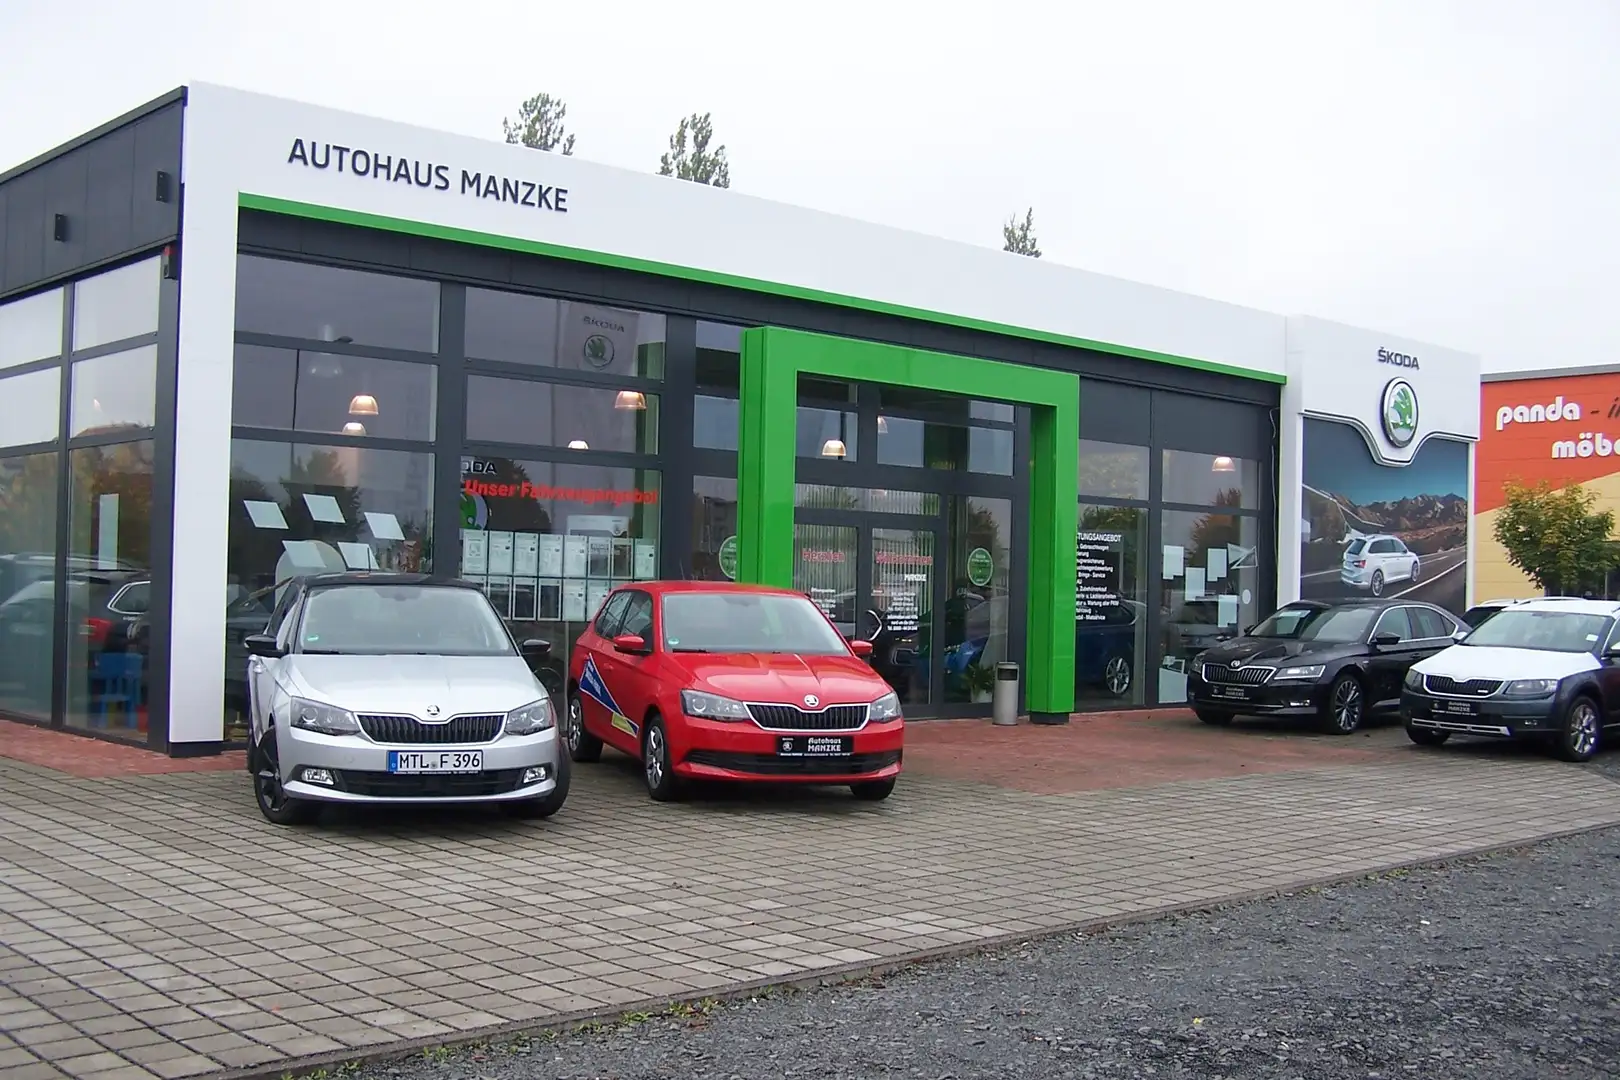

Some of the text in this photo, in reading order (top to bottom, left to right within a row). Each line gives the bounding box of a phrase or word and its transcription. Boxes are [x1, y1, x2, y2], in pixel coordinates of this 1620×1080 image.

[288, 138, 568, 212] AUTOHAUS MANZKE
[1378, 346, 1420, 370] ŠKODA
[1496, 396, 1581, 431] panda
[464, 479, 515, 498] Unser
[1077, 532, 1121, 542] TUNGSANGEBOT
[807, 744, 841, 752] MANZKE
[808, 737, 841, 745] Autohaus
[400, 753, 480, 768] MTL F 396
